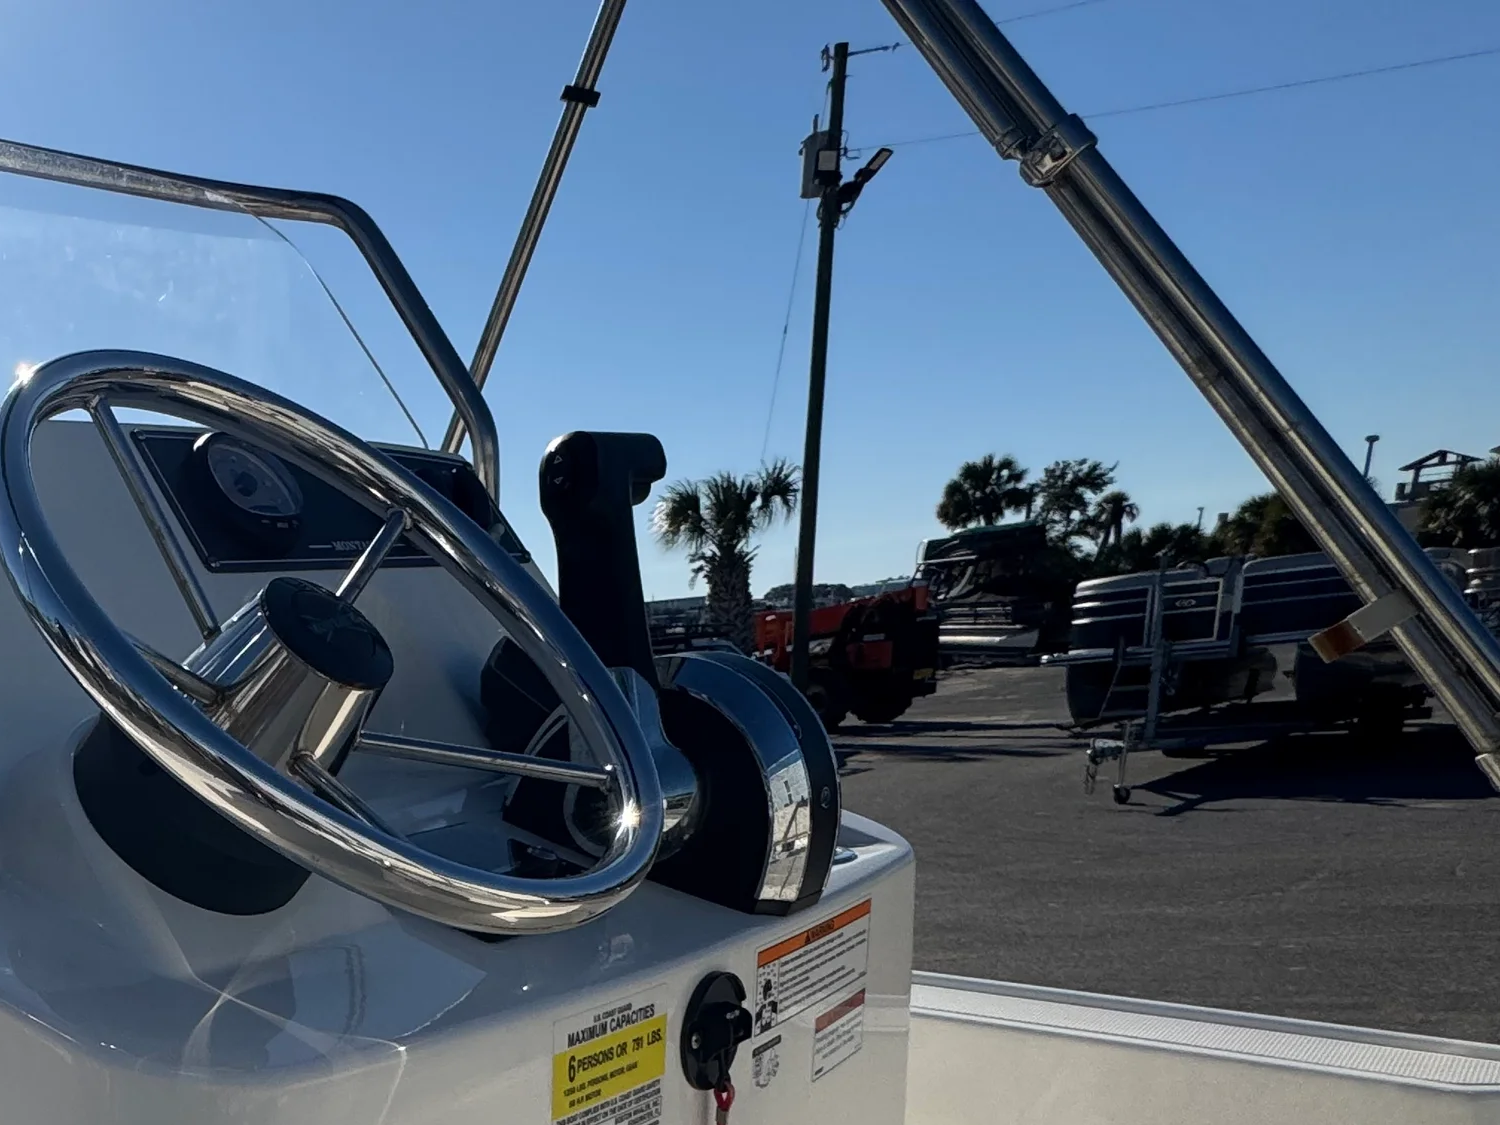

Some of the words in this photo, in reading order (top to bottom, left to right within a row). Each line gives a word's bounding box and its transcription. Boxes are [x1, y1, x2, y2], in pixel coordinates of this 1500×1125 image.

[331, 541, 372, 551] MONTA
[567, 1021, 608, 1048] MAXIMUM
[609, 1003, 655, 1032] CAPACITIES
[568, 1055, 576, 1083] 6
[577, 1046, 614, 1073] PERSONS
[616, 1041, 628, 1058] OR
[646, 1028, 663, 1046] LBS.
